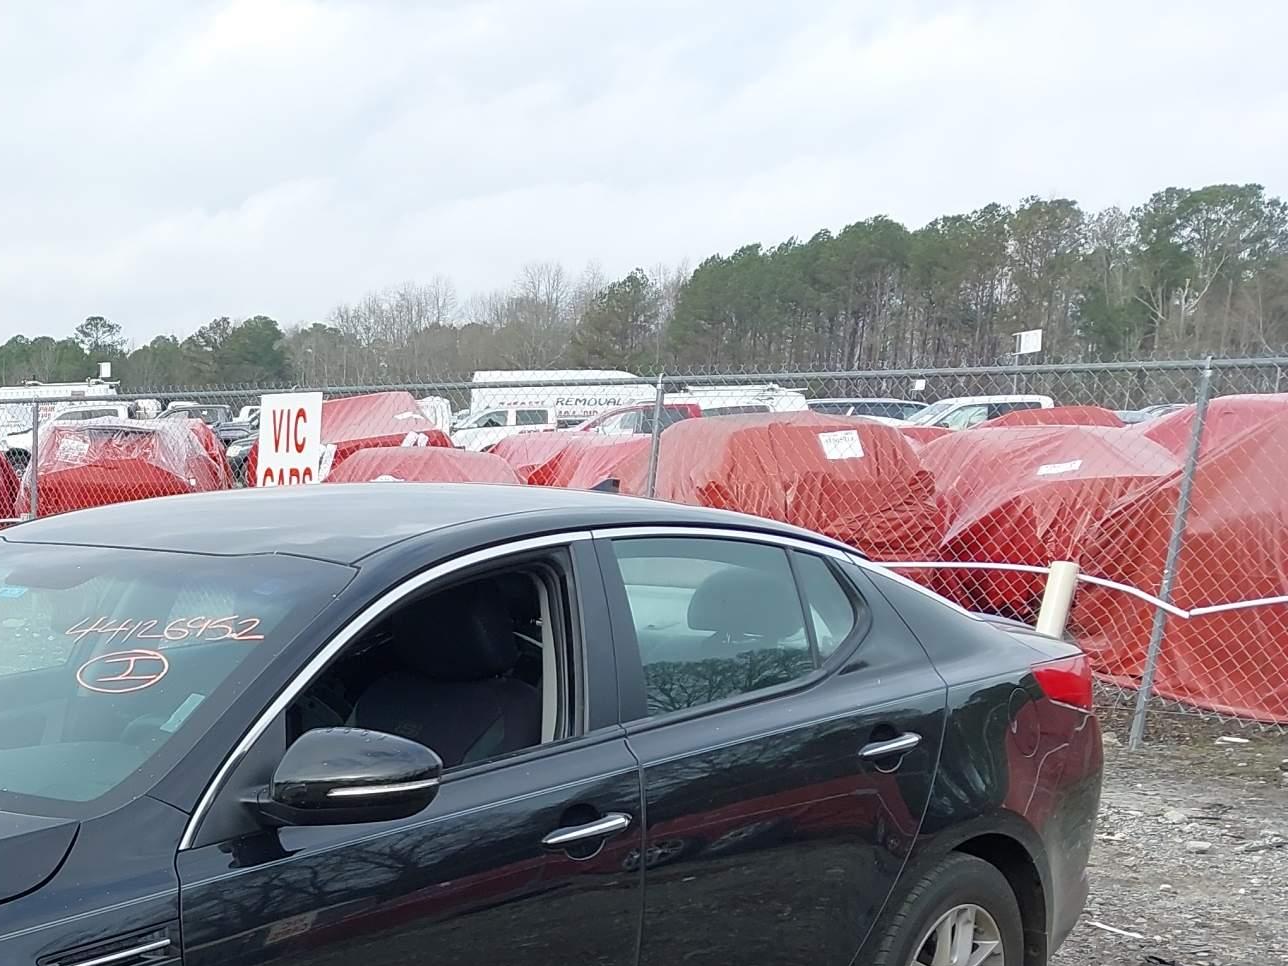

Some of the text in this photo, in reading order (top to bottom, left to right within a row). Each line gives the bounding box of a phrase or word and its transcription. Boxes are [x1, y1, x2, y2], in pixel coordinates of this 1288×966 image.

[555, 397, 623, 406] REMOVAL
[272, 408, 307, 453] VIC
[65, 615, 264, 645] 44126952
